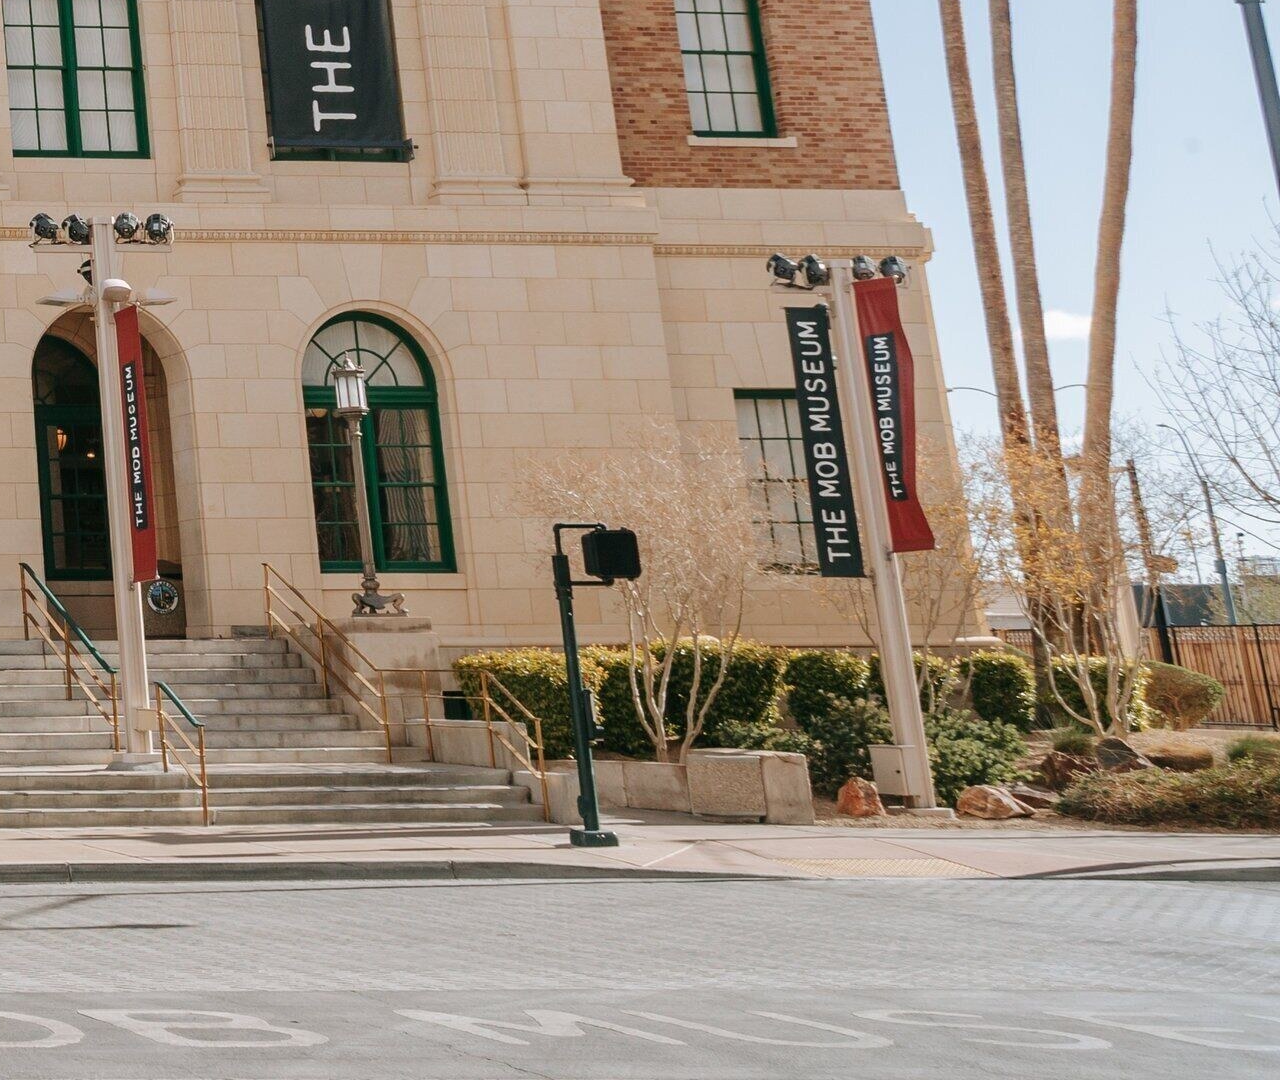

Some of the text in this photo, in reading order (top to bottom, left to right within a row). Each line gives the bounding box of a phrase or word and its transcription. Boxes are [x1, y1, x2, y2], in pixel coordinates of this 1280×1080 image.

[304, 24, 357, 132] THE
[796, 320, 852, 563] THE MOB MUSEUM
[873, 336, 904, 498] THE MOB MUSEUM
[134, 491, 144, 527] THE
[393, 1007, 1280, 1051] MUSE
